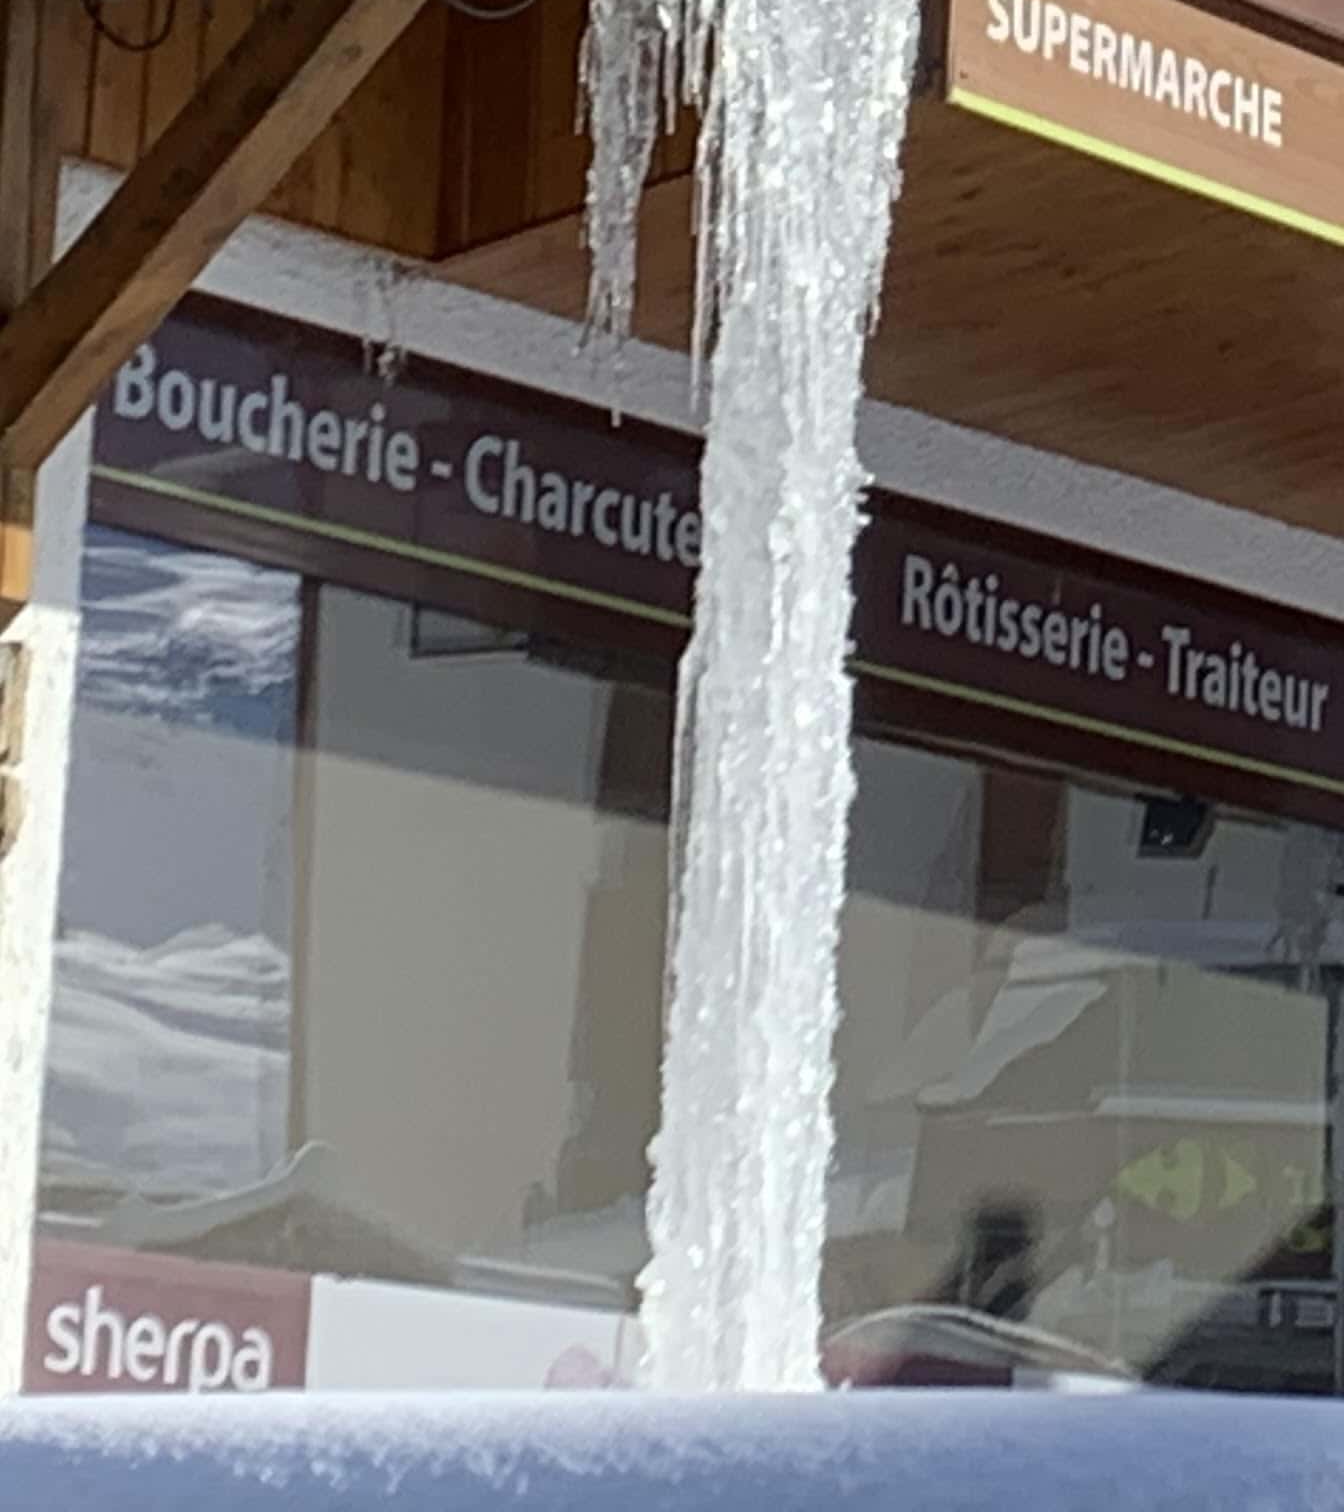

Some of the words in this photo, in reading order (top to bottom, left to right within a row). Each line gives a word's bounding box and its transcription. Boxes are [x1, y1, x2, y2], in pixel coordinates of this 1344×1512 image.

[112, 342, 420, 492] Boucherie
[901, 553, 1128, 682] Rôtisserie
[1160, 624, 1330, 733] Traiteur
[43, 1284, 273, 1393] sherpa
